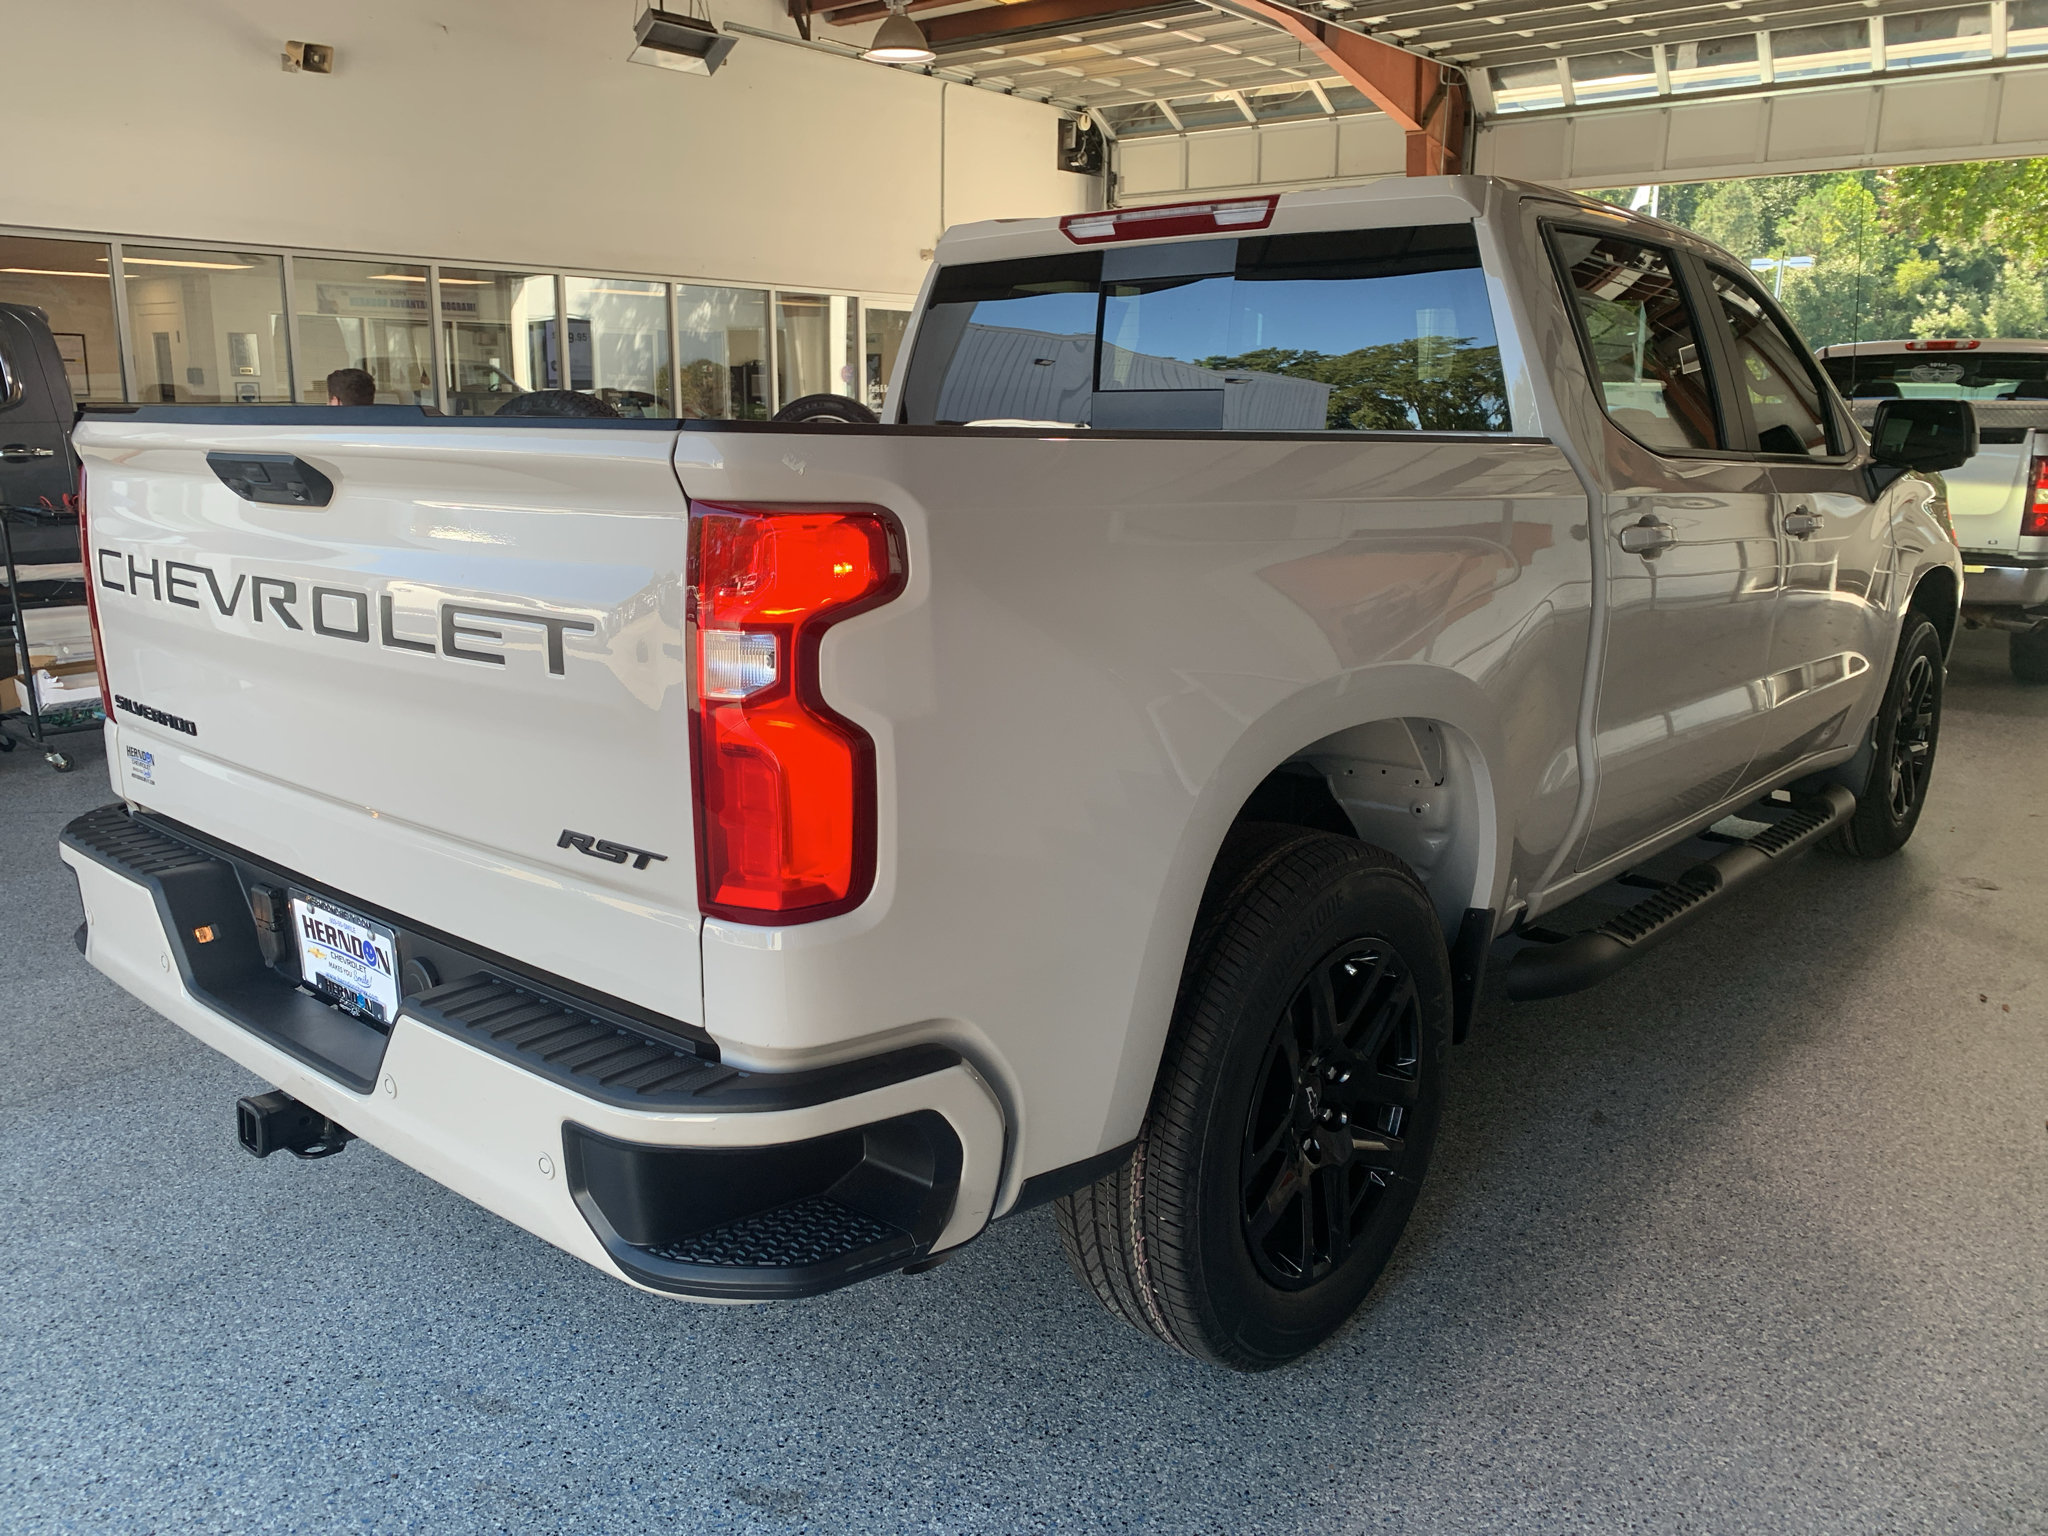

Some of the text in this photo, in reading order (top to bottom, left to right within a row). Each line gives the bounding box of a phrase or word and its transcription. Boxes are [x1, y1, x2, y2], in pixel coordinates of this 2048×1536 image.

[97, 547, 595, 676] CHEVROLET
[114, 694, 198, 737] SILVERADO
[126, 745, 155, 766] HERNDON
[556, 828, 668, 871] RST
[301, 914, 392, 976] HERNDON
[330, 951, 367, 975] CHEVROLET
[328, 961, 343, 974] MAKES
[342, 968, 353, 979] YOU
[325, 978, 374, 1013] HERNDON
